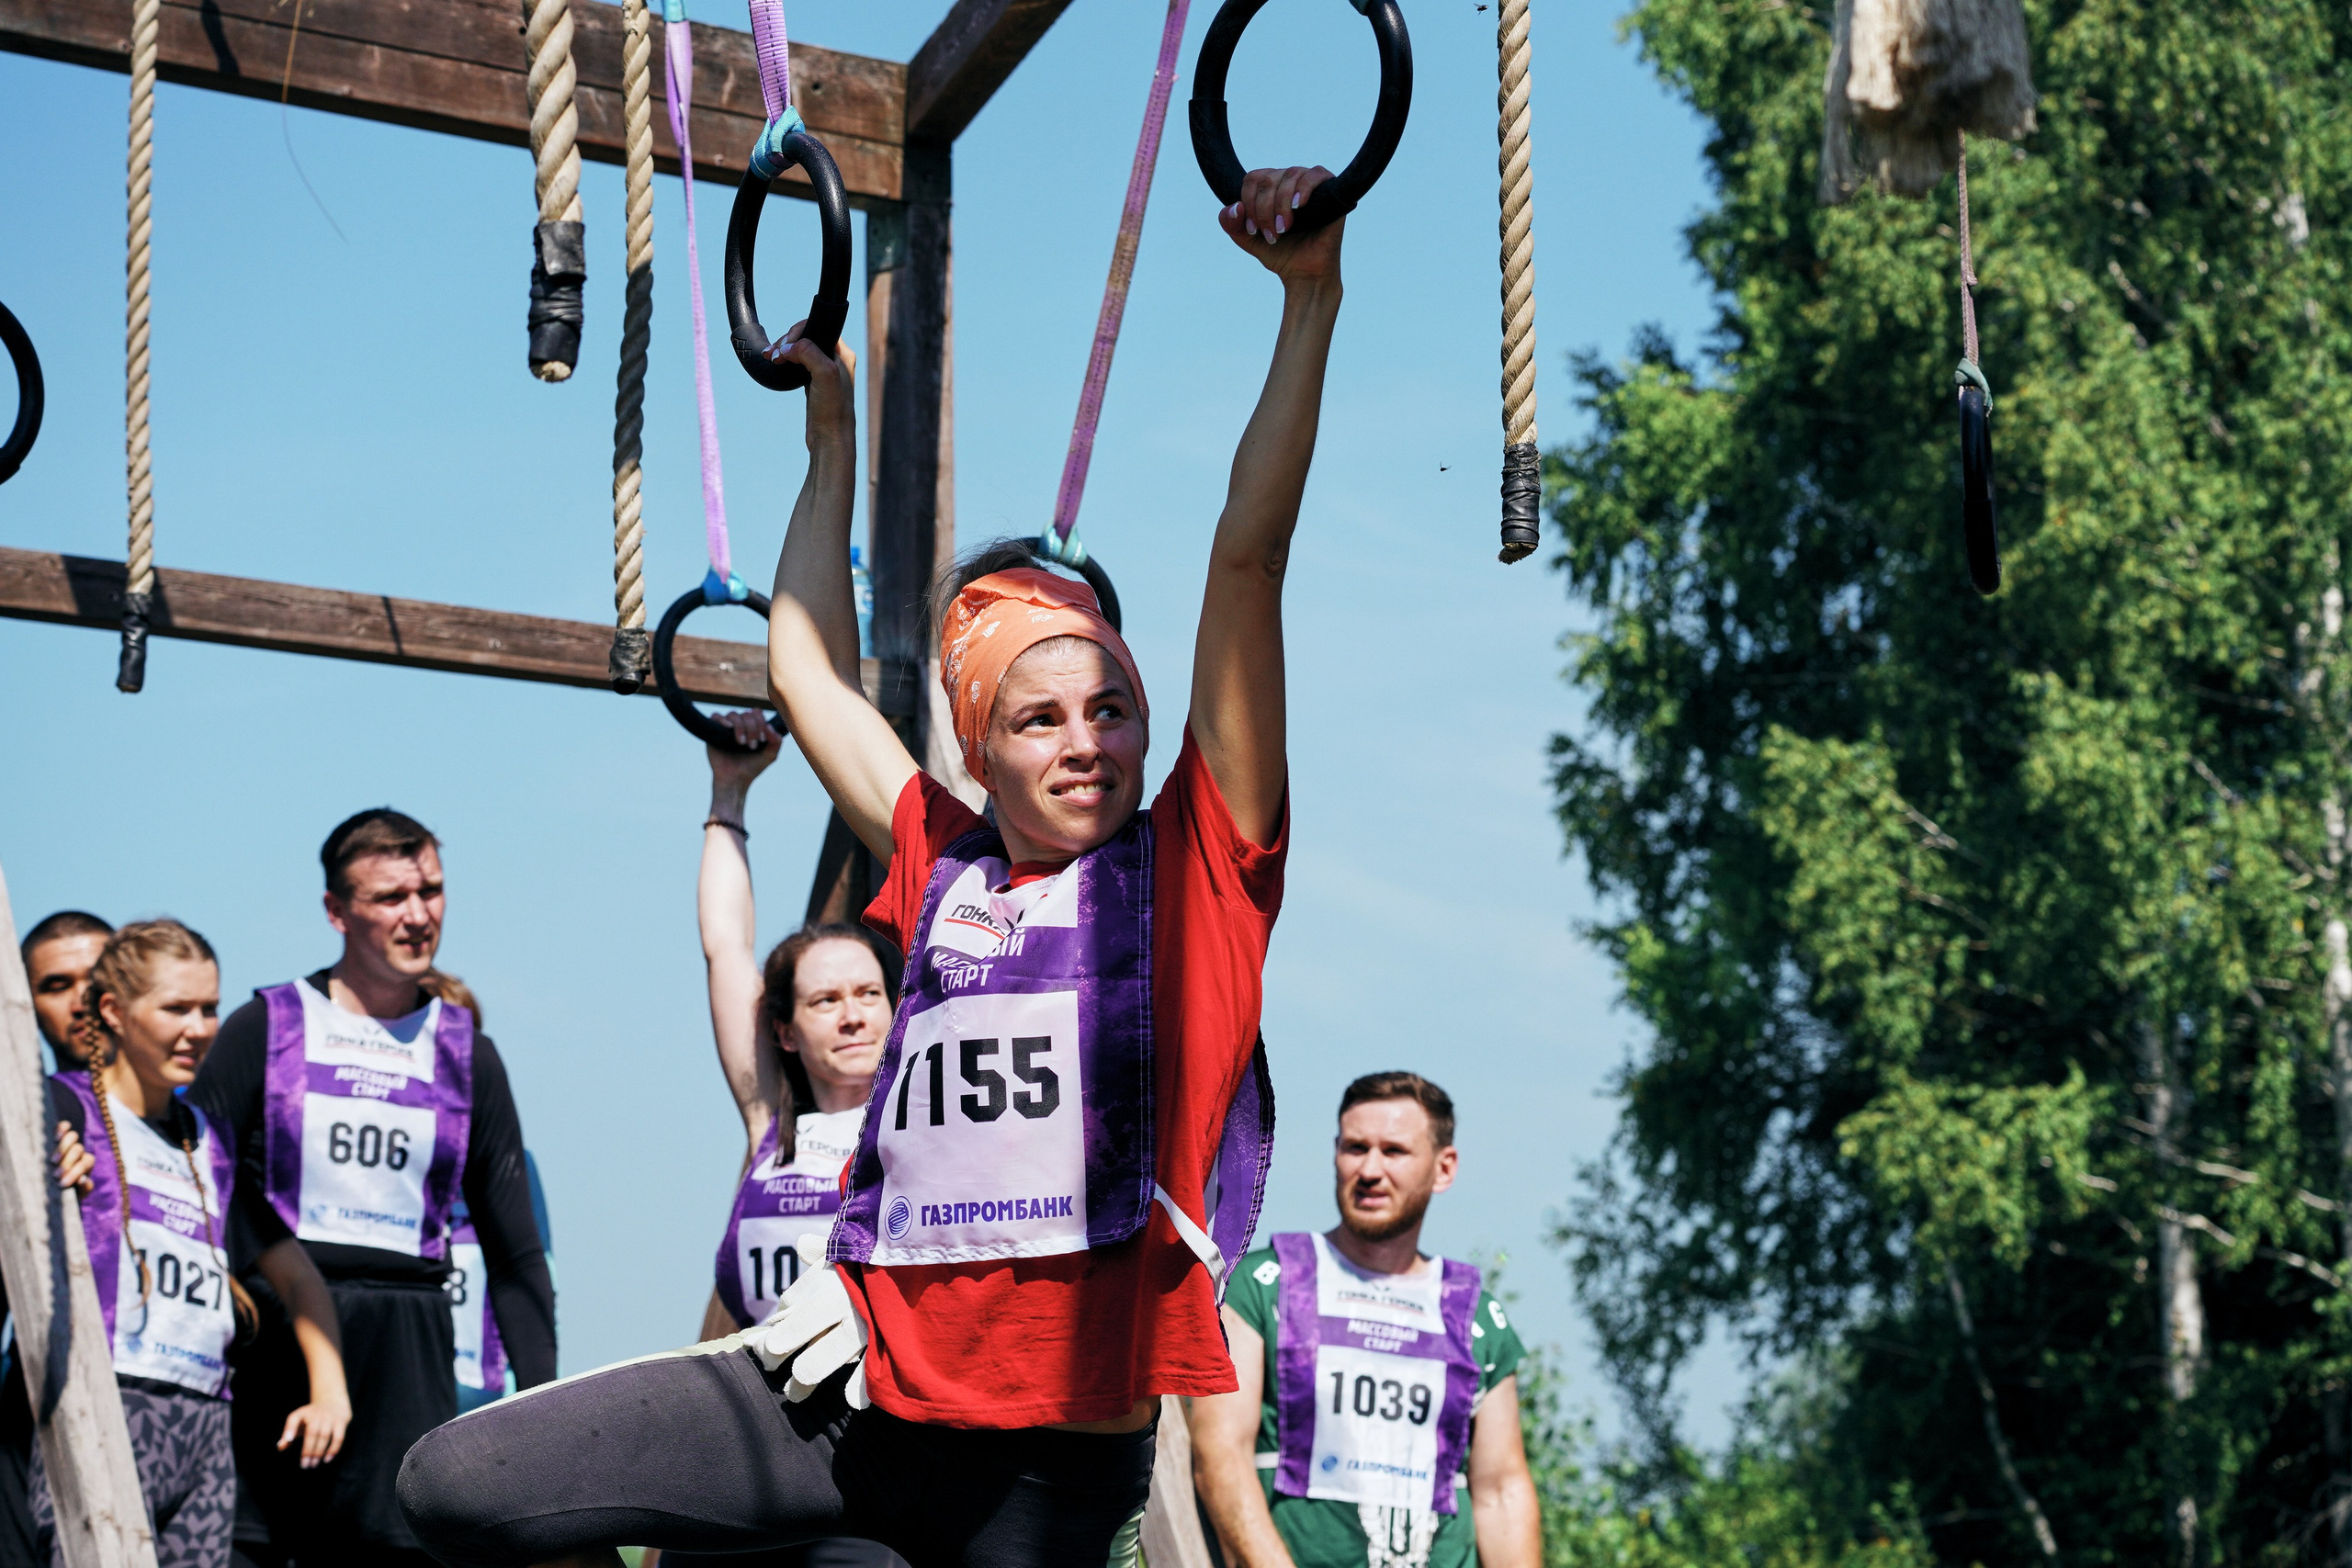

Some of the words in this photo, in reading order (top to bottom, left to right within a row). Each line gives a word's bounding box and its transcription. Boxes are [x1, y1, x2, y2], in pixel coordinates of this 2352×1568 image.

[940, 964, 994, 994] СТАРТ
[894, 1035, 1060, 1132] 1155
[329, 1121, 410, 1171] 606
[779, 1196, 821, 1213] СТАРТ
[921, 1195, 1073, 1228] ГАЗПРОМБАНК
[134, 1248, 222, 1311] 1027
[1363, 1336, 1403, 1354] СТАРТ
[1330, 1371, 1432, 1427] 1039
